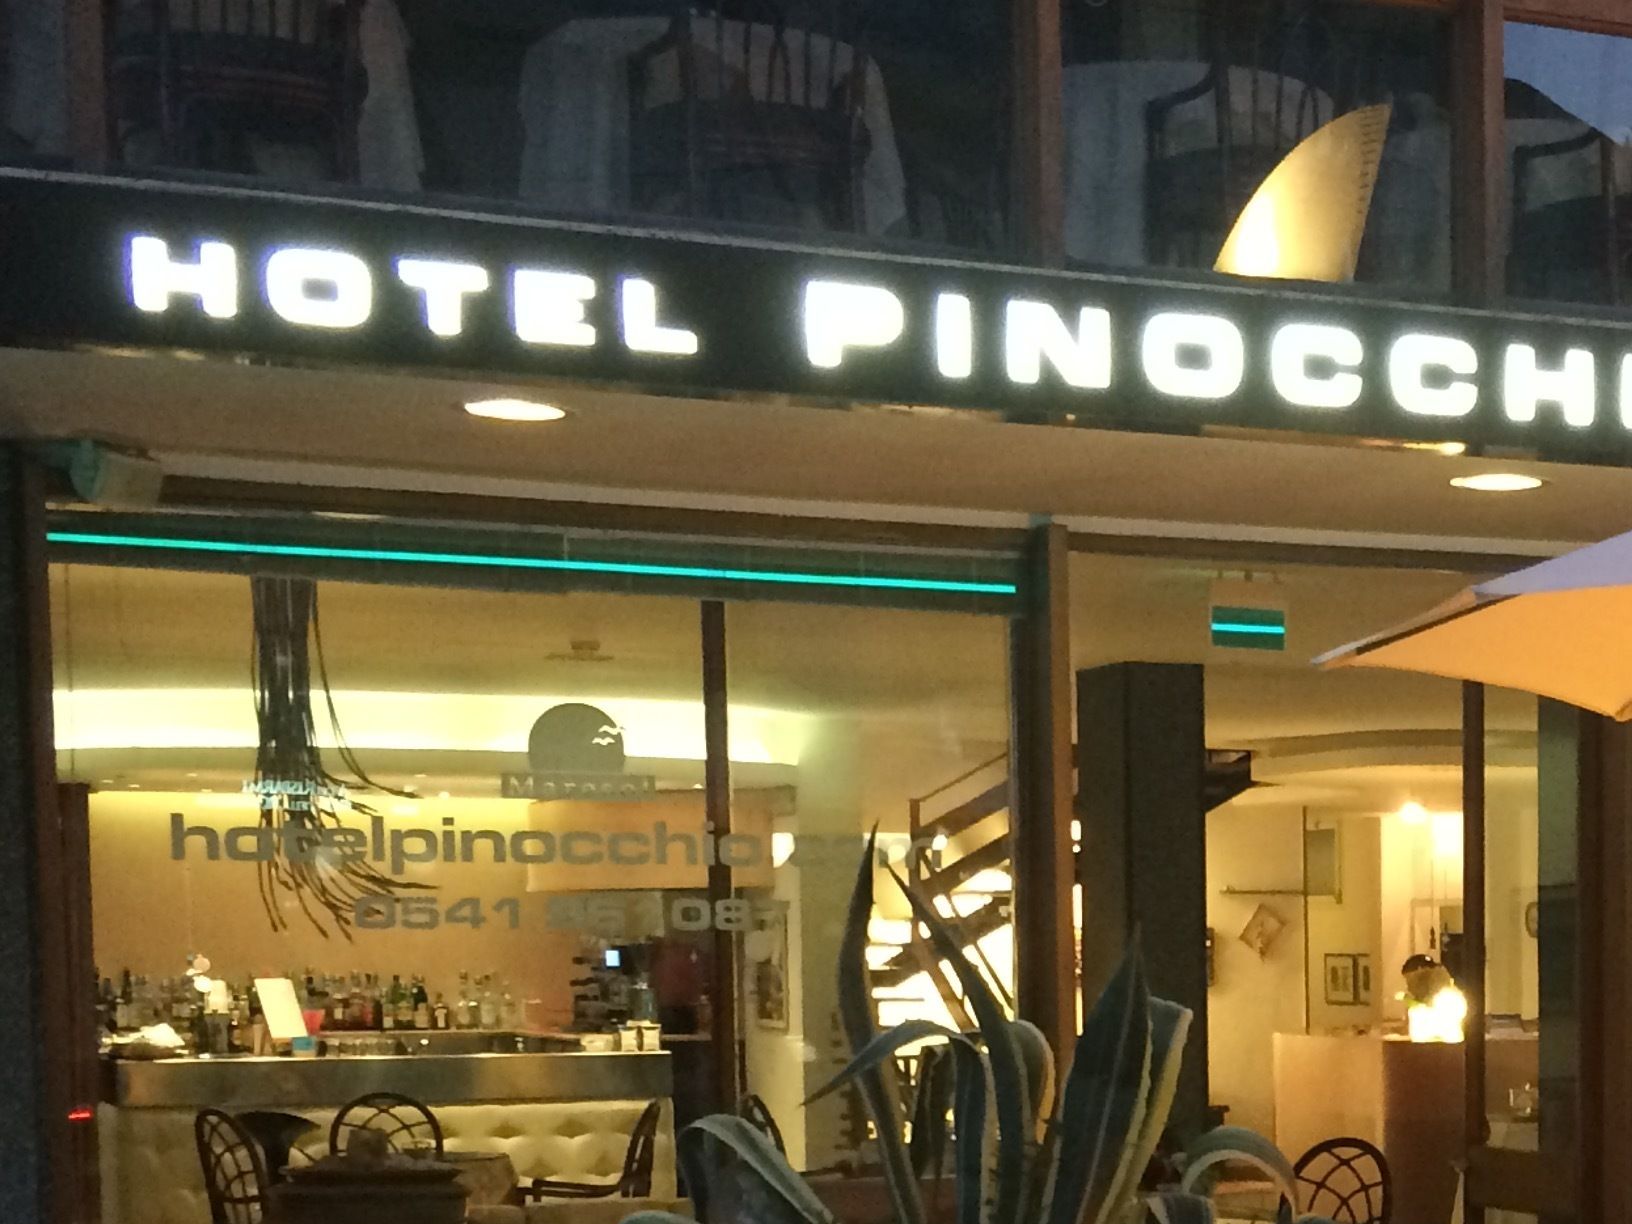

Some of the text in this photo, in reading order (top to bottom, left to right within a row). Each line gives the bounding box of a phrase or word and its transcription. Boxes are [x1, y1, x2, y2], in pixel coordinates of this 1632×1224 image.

[127, 234, 699, 356] HOTEL
[170, 812, 943, 876] hotelpinocchiocom
[355, 896, 521, 930] 0541
